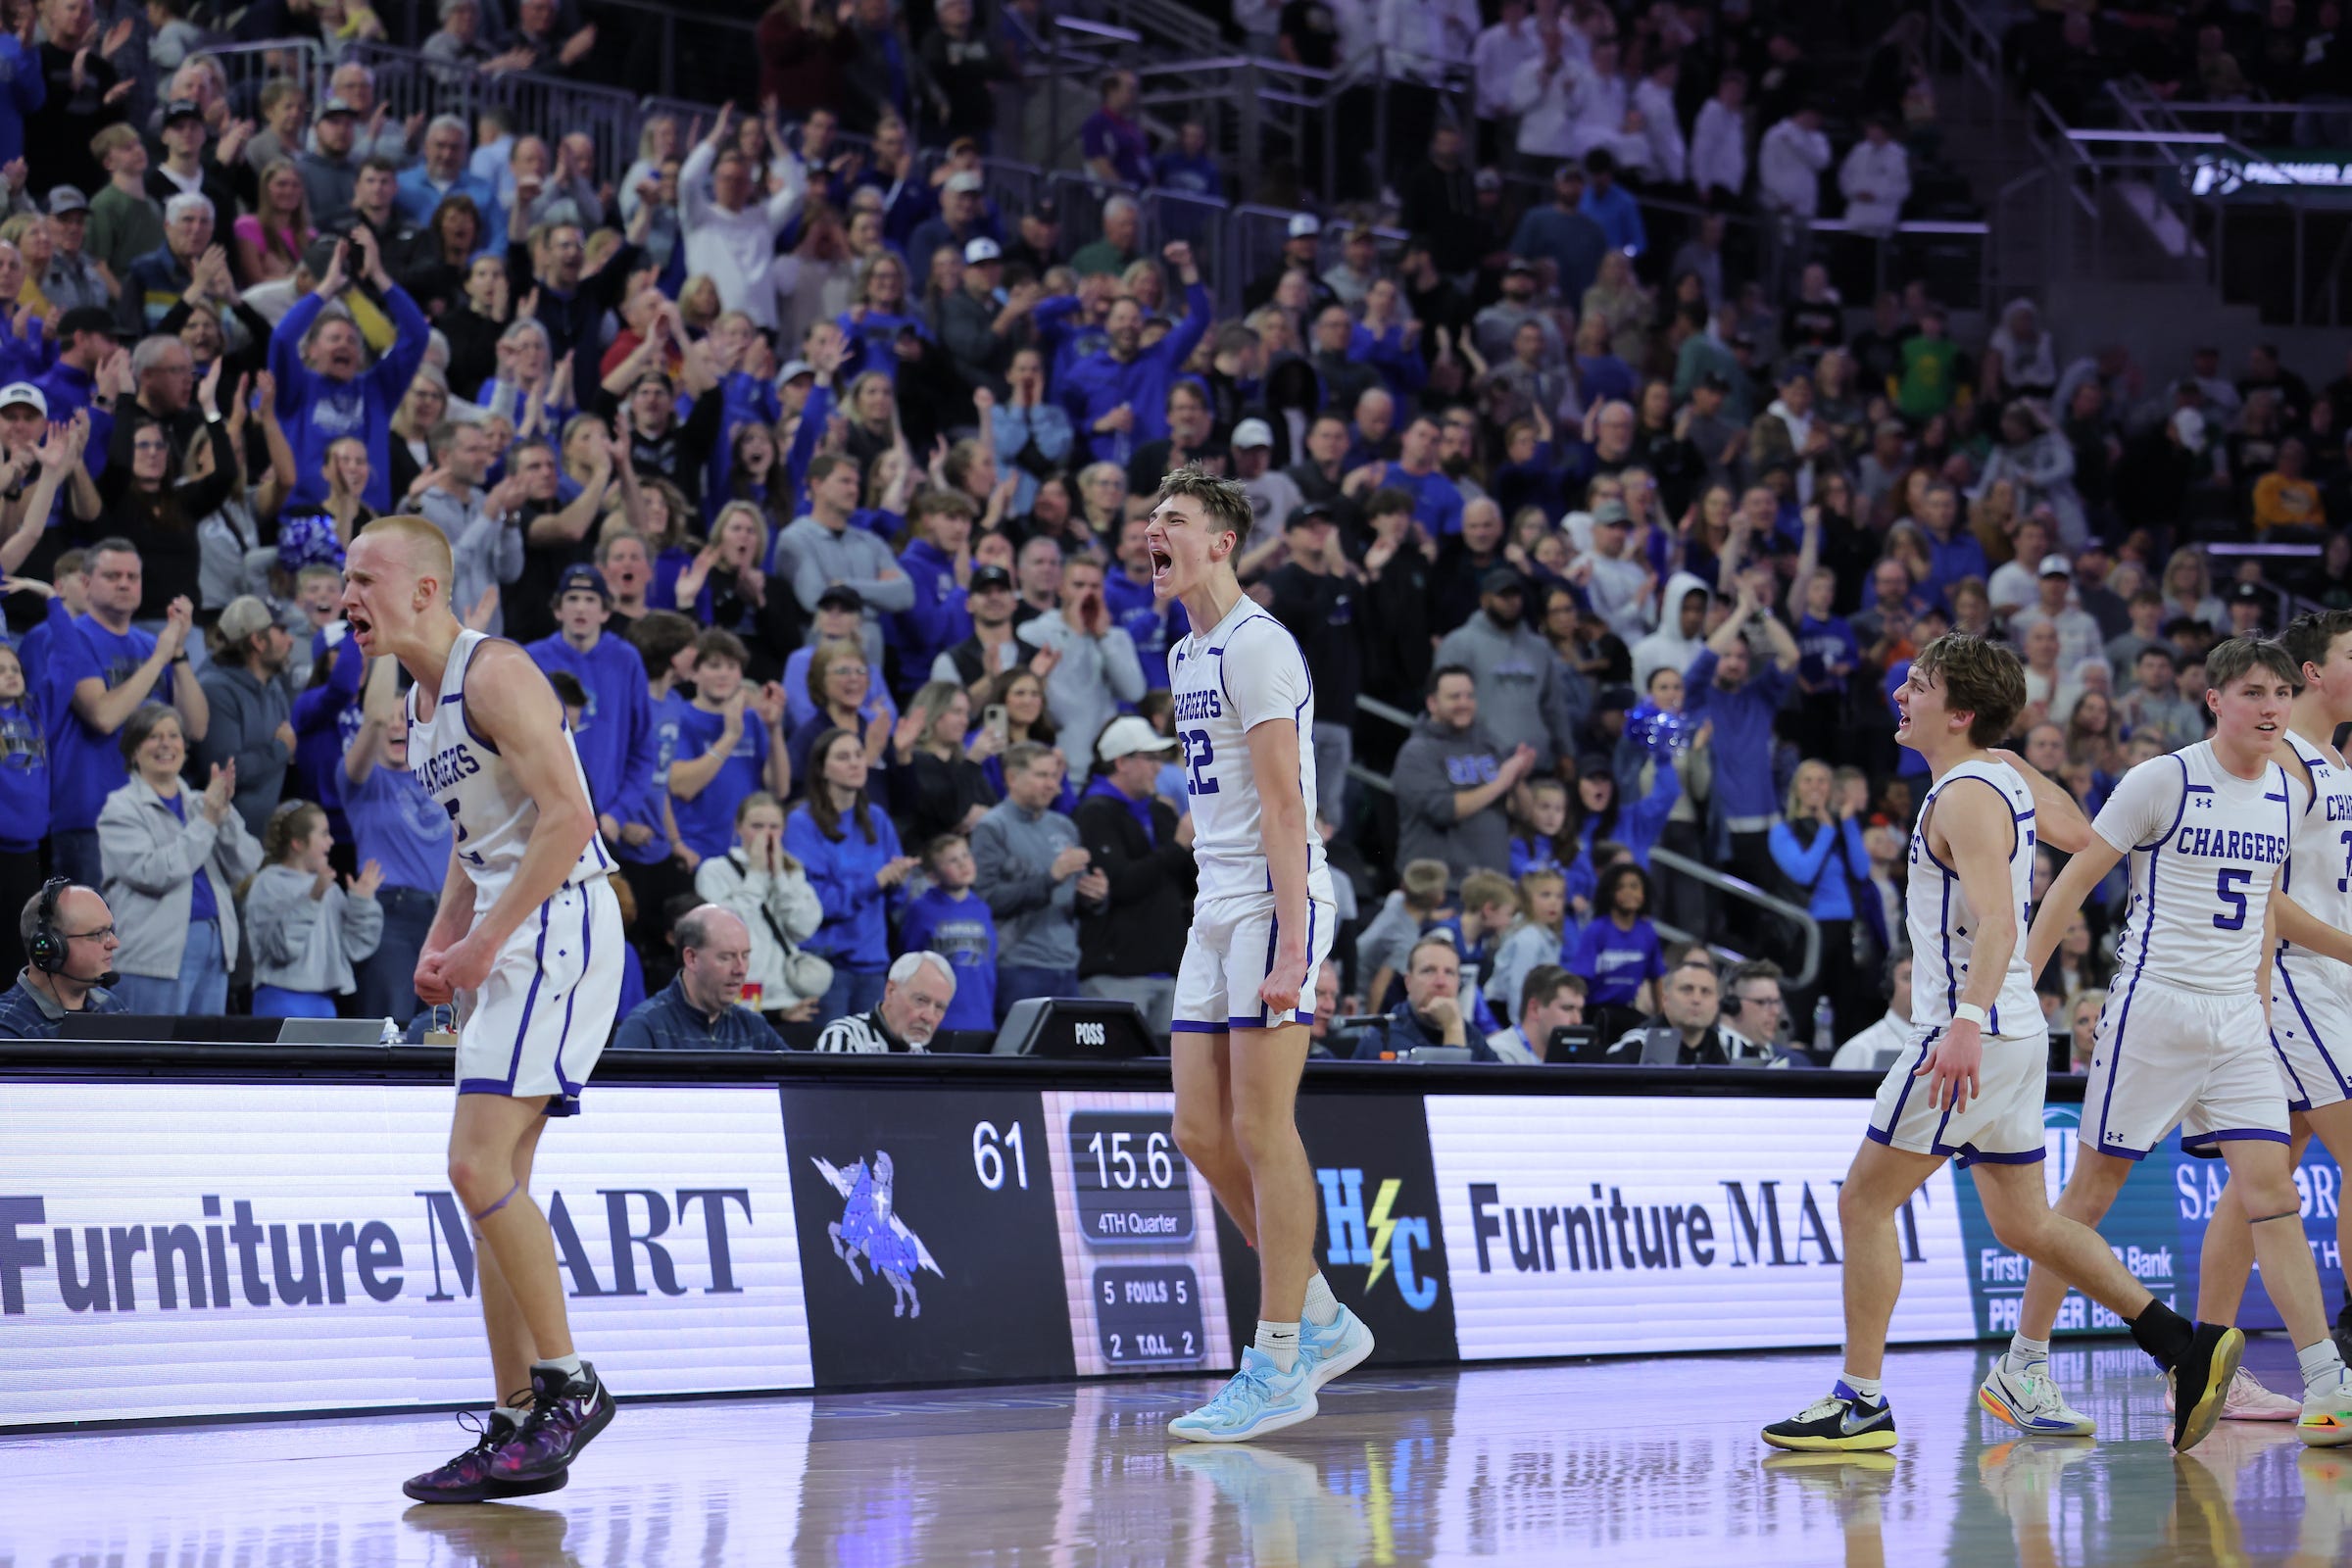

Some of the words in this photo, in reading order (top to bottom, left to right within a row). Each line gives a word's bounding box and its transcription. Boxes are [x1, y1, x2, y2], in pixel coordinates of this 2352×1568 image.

[1175, 690, 1221, 722] HARGERS
[1179, 729, 1219, 795] 22
[2177, 826, 2285, 864] CHARGERS
[2213, 867, 2253, 931] 5
[1074, 1022, 1105, 1046] POSS
[972, 1120, 1029, 1190] 61
[1088, 1131, 1173, 1190] 15.6
[1099, 1212, 1127, 1234] 4TH
[1128, 1212, 1178, 1235] Quarter
[1468, 1183, 1715, 1274] Furniture
[1719, 1180, 1930, 1267] MAT
[0, 1194, 404, 1314] Furniture
[1981, 1248, 2027, 1282] First
[2127, 1245, 2173, 1278] Bank
[1103, 1280, 1115, 1304] 5
[1124, 1280, 1169, 1303] FOULS
[1175, 1280, 1188, 1304] 5
[1109, 1333, 1123, 1357] 2
[1135, 1334, 1174, 1356] T.O.L.
[1182, 1331, 1195, 1354] 2
